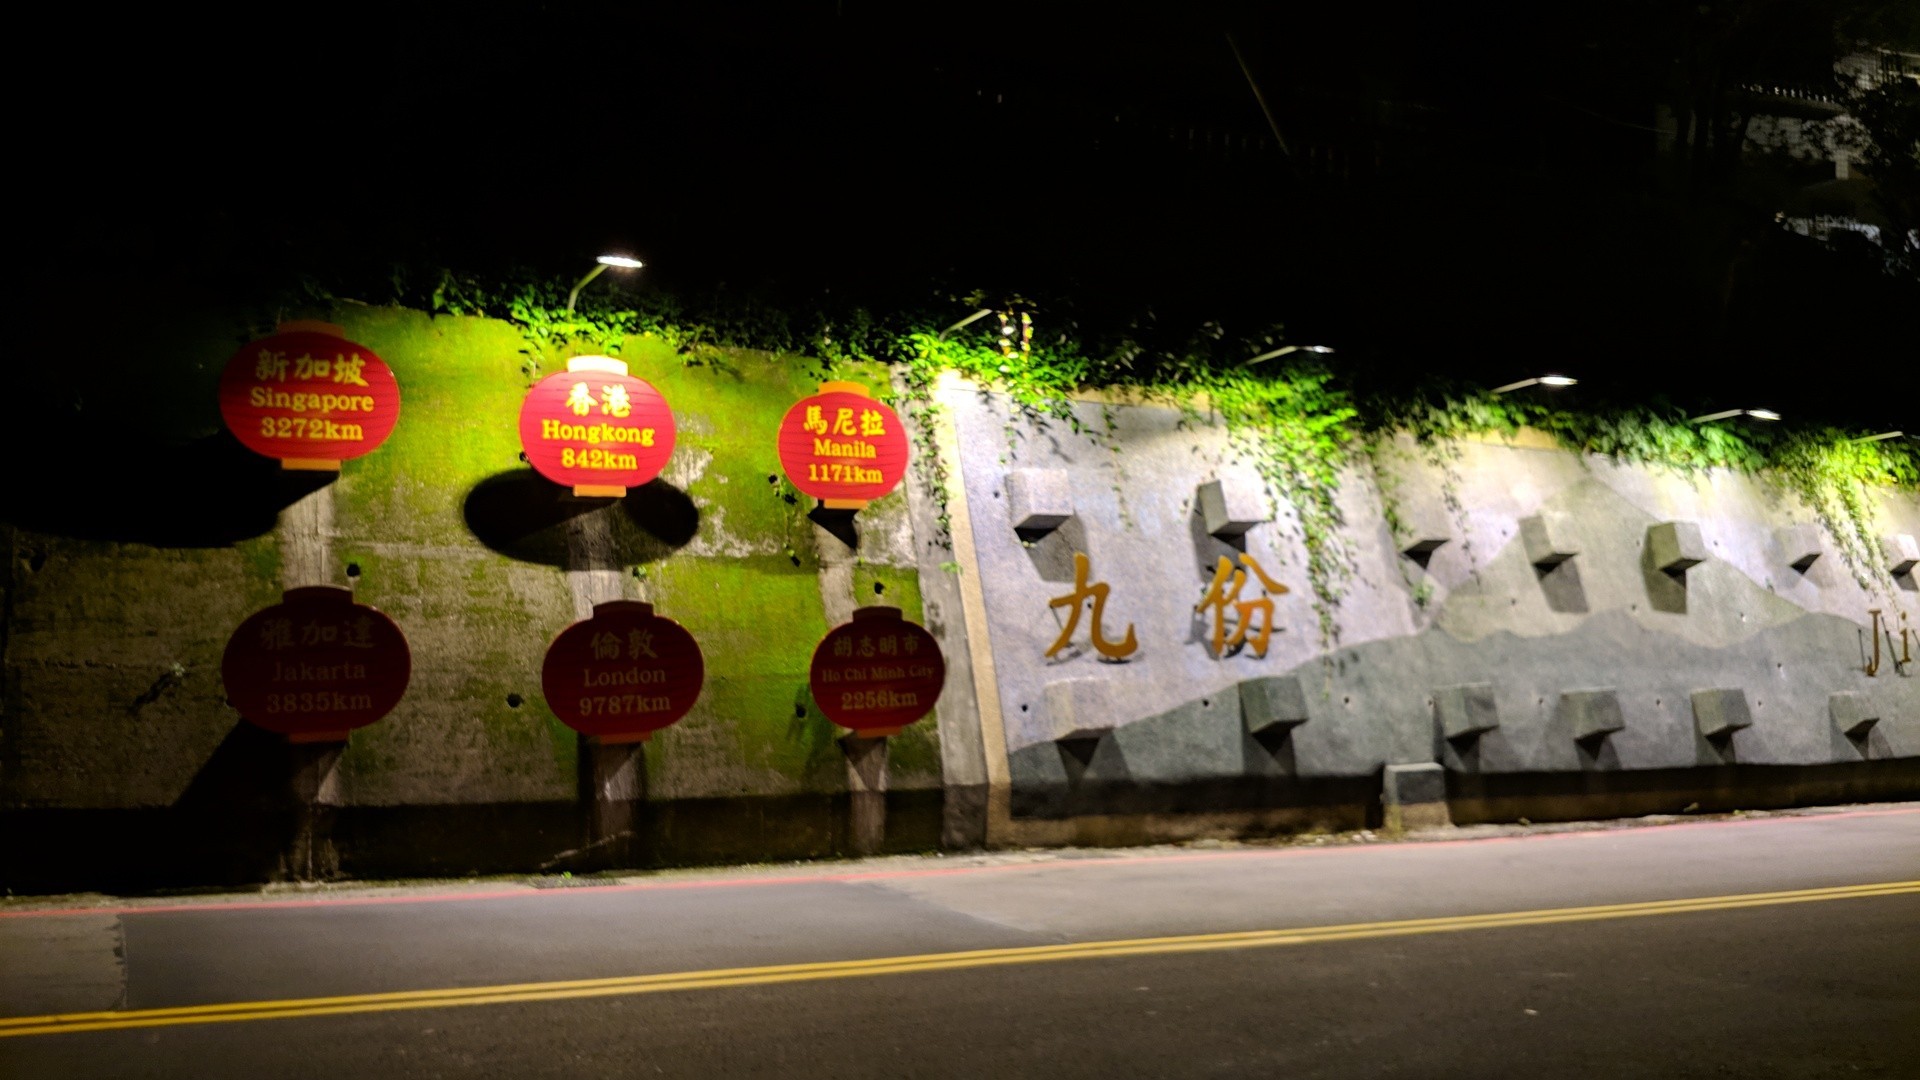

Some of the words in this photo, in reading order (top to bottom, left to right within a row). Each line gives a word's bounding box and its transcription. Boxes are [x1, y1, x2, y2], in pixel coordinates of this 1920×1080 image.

[256, 348, 369, 387] 新加坡
[250, 387, 375, 413] Singapore
[565, 382, 632, 418] 香港
[260, 416, 364, 441] 3272km
[541, 419, 656, 447] Hongkong
[803, 404, 887, 437] 馬尼拉
[561, 447, 638, 471] 842km
[814, 438, 876, 459] Manila
[808, 463, 884, 484] 1171km
[1044, 551, 1289, 659] 九份
[260, 615, 379, 651] 雅加達
[590, 627, 659, 662] 倫敦
[833, 632, 920, 658] 胡志明市
[272, 660, 366, 682] Jakarta
[583, 667, 667, 689] London
[822, 668, 841, 683] Ho
[844, 666, 868, 681] Chi
[871, 663, 906, 681] Minh
[909, 662, 935, 680] City
[266, 691, 373, 714] 3835km
[578, 692, 672, 717] 9787km
[840, 688, 919, 711] 2256km
